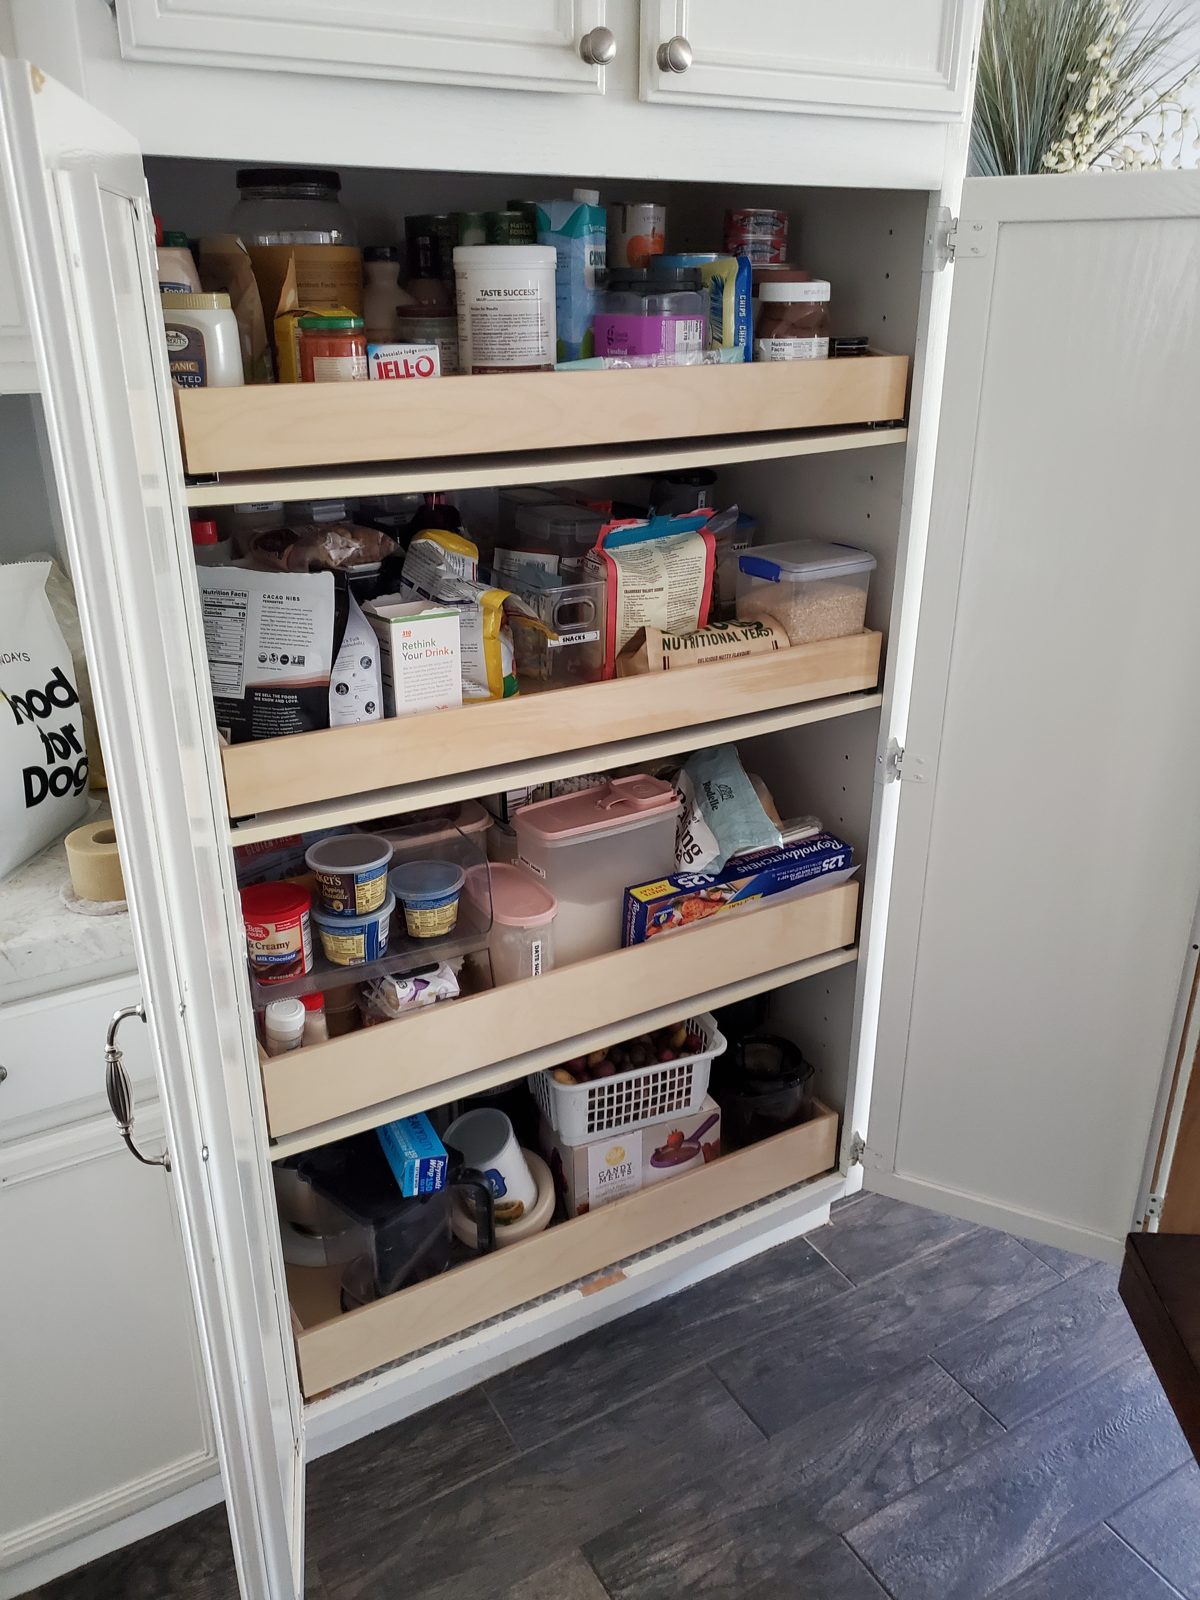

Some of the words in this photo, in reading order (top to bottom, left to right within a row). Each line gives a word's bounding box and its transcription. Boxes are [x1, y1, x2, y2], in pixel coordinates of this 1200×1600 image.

[480, 289, 502, 297] TASTE
[230, 590, 248, 598] Facts
[262, 593, 284, 601] CACAO
[401, 638, 436, 651] Rethink
[562, 635, 586, 643] SNACKS
[661, 630, 742, 652] NUTRITIONAL
[401, 651, 424, 661] Your
[702, 781, 720, 812] Rodelle
[785, 838, 843, 861] Reynolds
[736, 853, 789, 873] KITCHENS
[821, 854, 846, 872] 125
[255, 940, 290, 951] Creamy
[268, 953, 296, 962] Chocolate
[434, 1159, 444, 1190] Reynolds
[598, 1161, 632, 1178] CANDY
[598, 1170, 632, 1185] MELTS
[425, 1178, 434, 1192] 150
